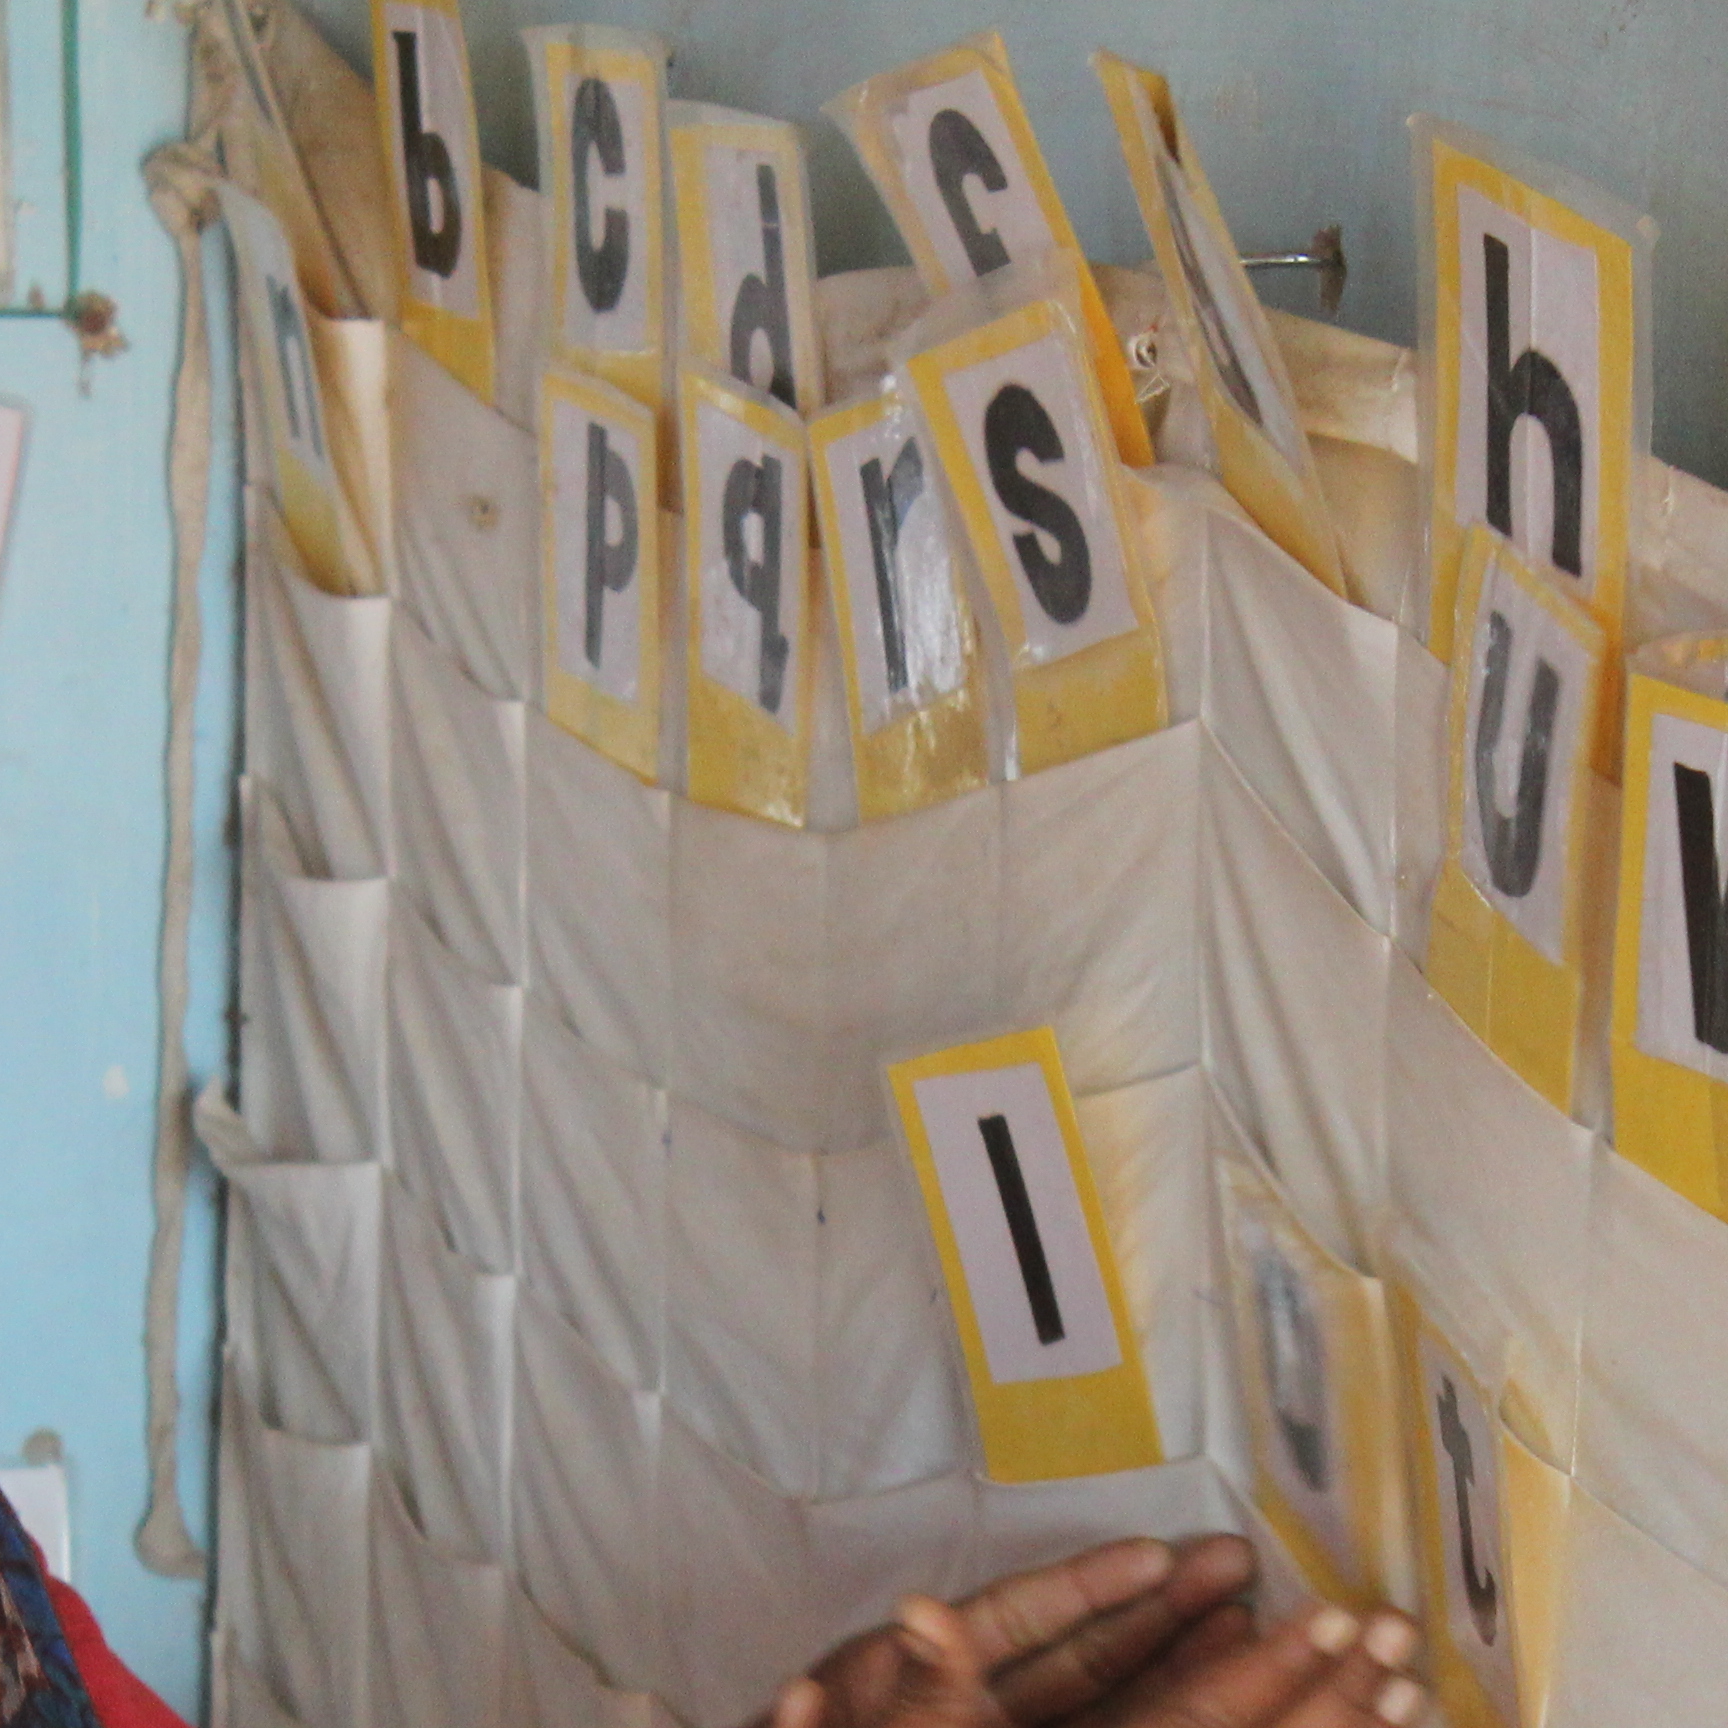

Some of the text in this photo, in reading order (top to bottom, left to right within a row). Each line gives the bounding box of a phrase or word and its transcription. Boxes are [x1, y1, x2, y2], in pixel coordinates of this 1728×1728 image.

[393, 31, 462, 279] b
[573, 78, 630, 313] c
[729, 163, 796, 411] d
[1482, 233, 1582, 579] h
[584, 422, 639, 671] p
[722, 453, 790, 714] q
[983, 382, 1093, 626] s
